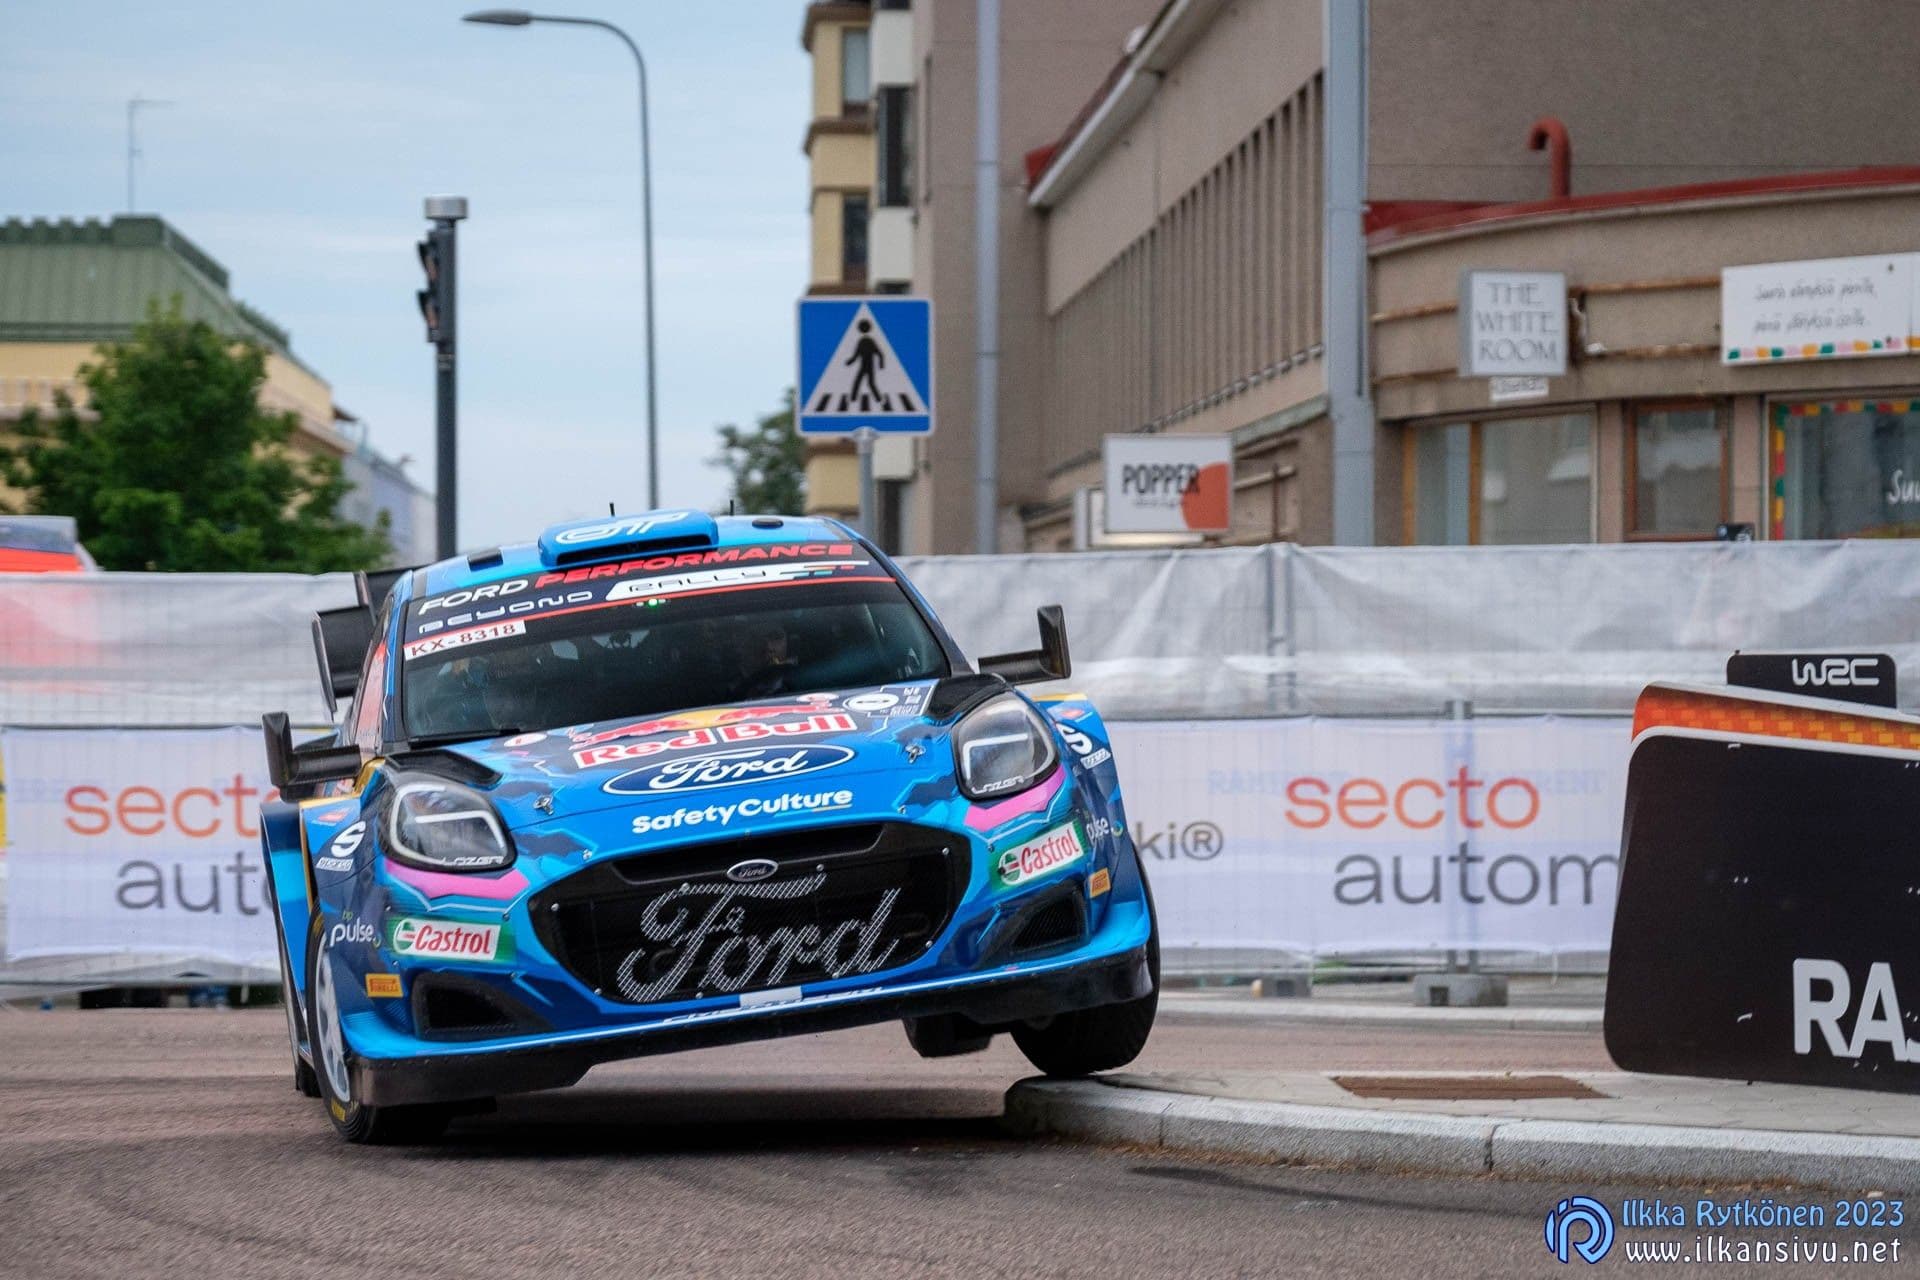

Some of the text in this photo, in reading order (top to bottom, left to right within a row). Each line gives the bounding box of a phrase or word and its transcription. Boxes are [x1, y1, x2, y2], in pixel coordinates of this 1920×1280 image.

[1487, 282, 1542, 305] THE
[1475, 309, 1560, 333] WHITE
[1479, 337, 1557, 361] ROOM
[1121, 464, 1200, 495] POPPER
[418, 543, 853, 616] FORD PERFORMANCE
[411, 623, 516, 656] KX-8318
[1791, 658, 1880, 686] WRC
[573, 713, 857, 768] Red Bull
[649, 750, 809, 790] Ford
[64, 773, 281, 839] sect
[632, 789, 853, 834] SafetyCulture
[1284, 764, 1541, 830] secto
[1020, 829, 1079, 875] Castrol
[414, 925, 492, 955] Castrol
[616, 873, 900, 1002] Ford
